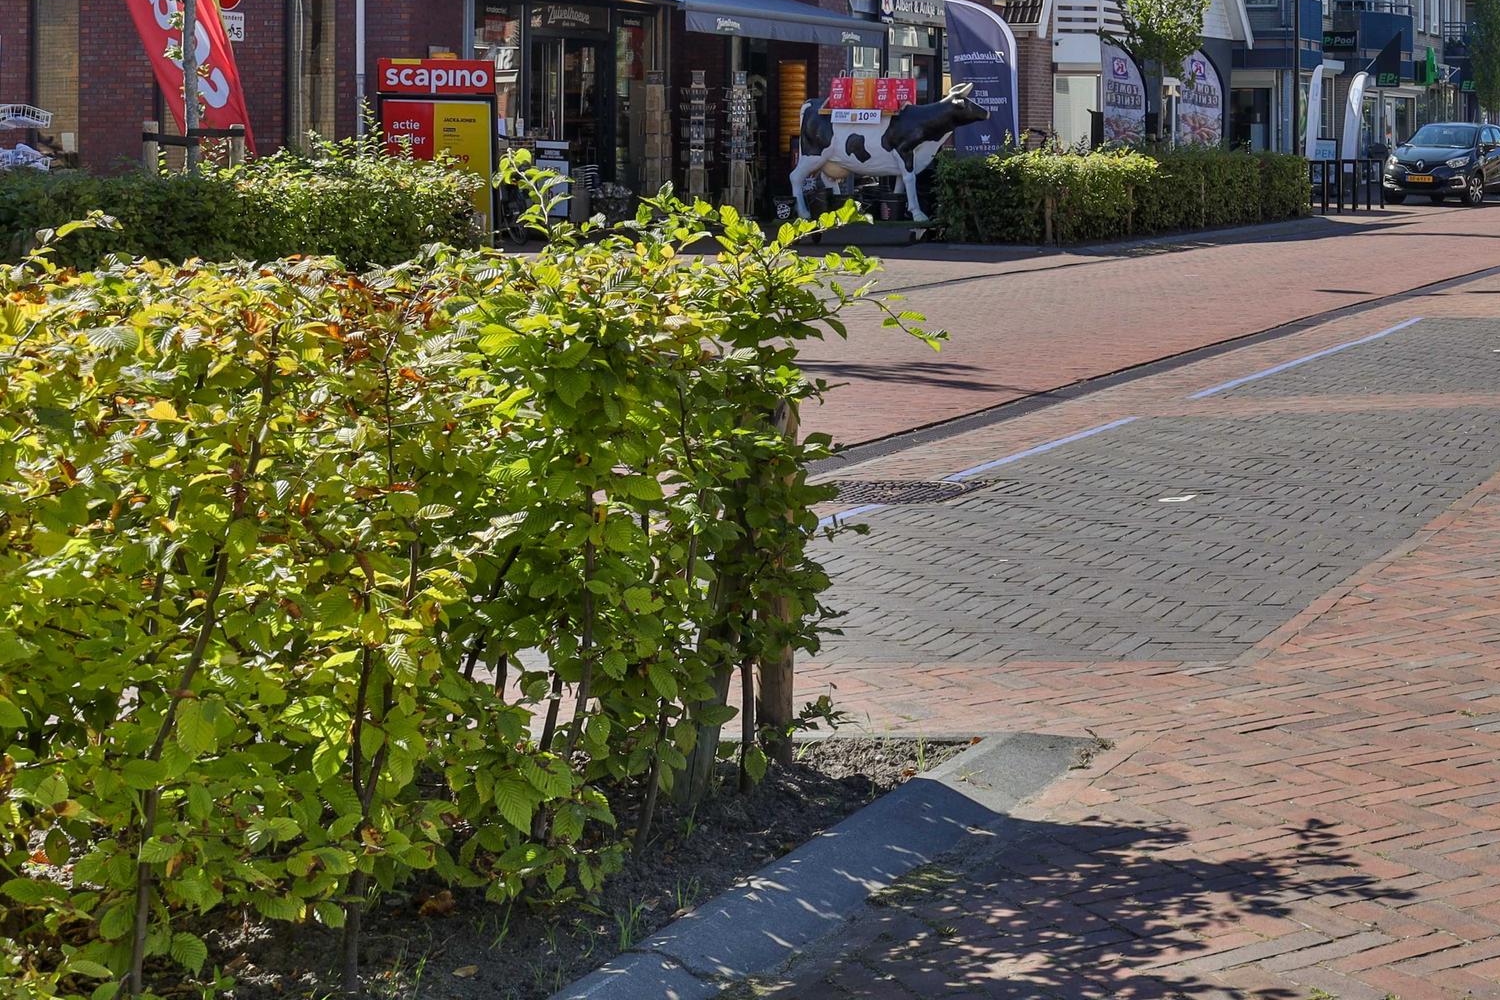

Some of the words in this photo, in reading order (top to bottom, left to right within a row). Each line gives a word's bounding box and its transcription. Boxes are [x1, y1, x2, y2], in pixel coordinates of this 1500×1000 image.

[548, 5, 590, 24] Zuivelhoeve
[914, 1, 919, 13] &
[386, 68, 488, 94] scapino
[393, 119, 420, 130] actie
